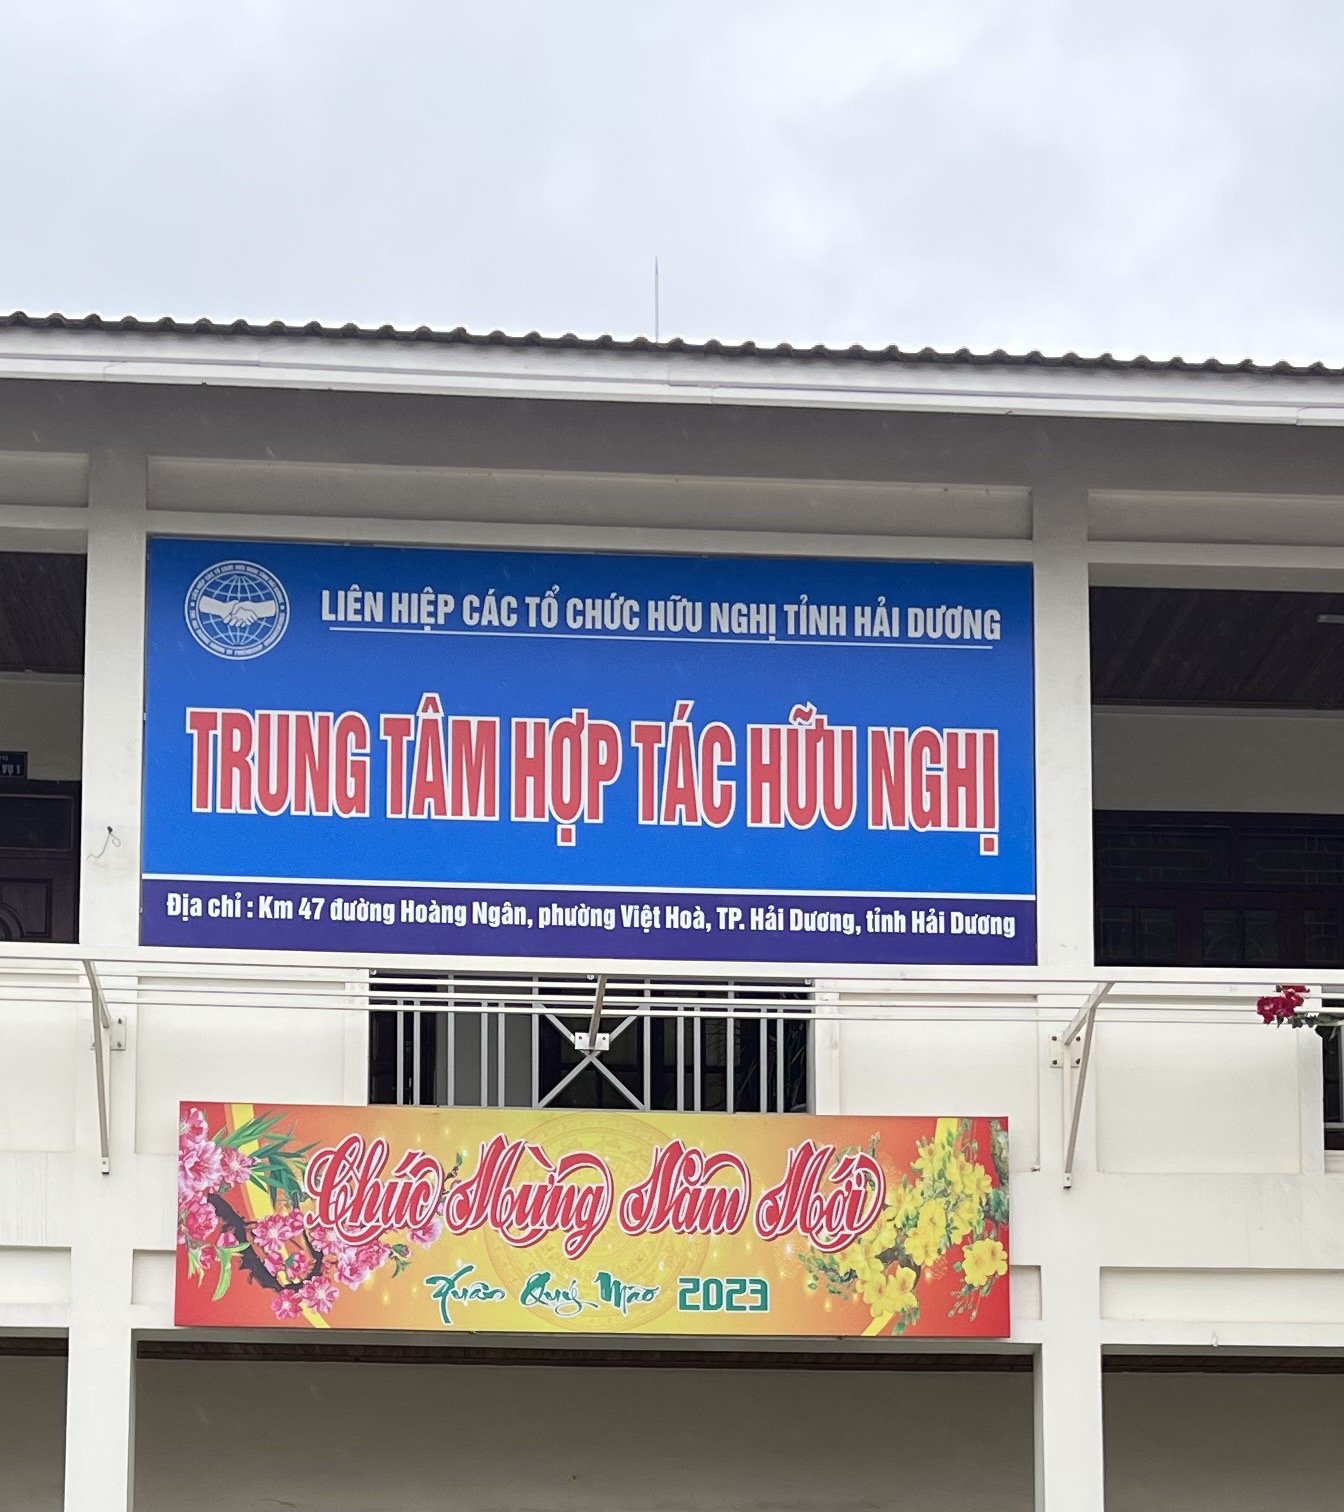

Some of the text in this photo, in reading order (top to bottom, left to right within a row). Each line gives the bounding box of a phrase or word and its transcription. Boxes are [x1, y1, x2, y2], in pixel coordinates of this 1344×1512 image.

[321, 584, 384, 623] LIÊN
[391, 586, 455, 631] HIỆP
[462, 588, 518, 627] CÁC
[525, 584, 560, 629] TỔ
[566, 592, 640, 631] CHỨC
[647, 594, 703, 633] HỮU
[710, 602, 776, 641] NGHỊ
[783, 593, 847, 636] TỈNH
[854, 596, 900, 638] HẢI
[907, 605, 1001, 641] DƯƠNG
[186, 692, 999, 856] TRUNG TÂM HỢP TÁC HỮU NGHỊ
[166, 892, 202, 923] Địa
[208, 891, 241, 918] chỉ
[258, 896, 294, 920] Km
[298, 898, 325, 920] 47
[329, 898, 396, 925] đường
[400, 900, 467, 927] Hoàng
[472, 901, 533, 928] Ngân,
[538, 903, 616, 931] phường
[620, 904, 661, 933] Việt
[665, 905, 711, 933] Hoà,
[716, 907, 745, 930] TP.
[750, 905, 784, 931] Hải
[789, 908, 861, 936] Dương,
[866, 907, 906, 933] tỉnh
[911, 908, 945, 934] Hải
[950, 911, 1016, 938] Dương
[305, 1132, 886, 1260] Chúc Mừng Năm Mới
[424, 1263, 506, 1325] Xuân
[519, 1270, 599, 1317] Quý
[677, 1276, 770, 1313] 2023
